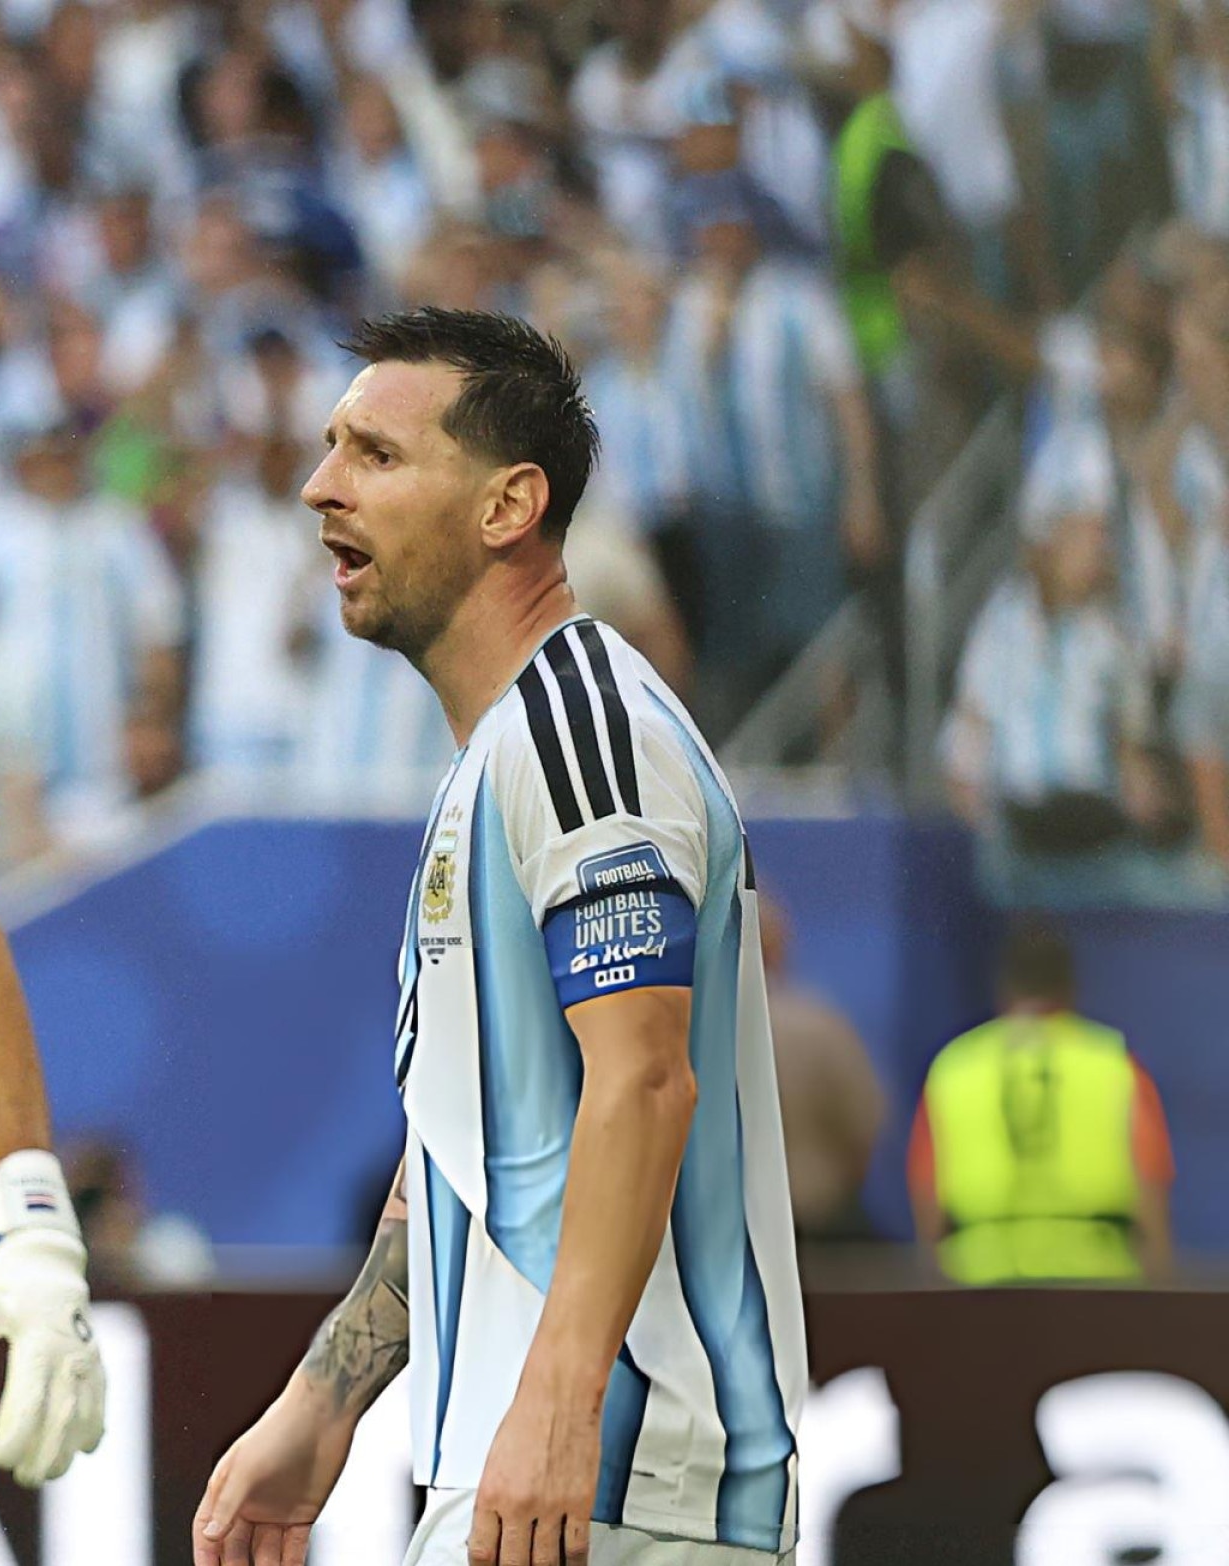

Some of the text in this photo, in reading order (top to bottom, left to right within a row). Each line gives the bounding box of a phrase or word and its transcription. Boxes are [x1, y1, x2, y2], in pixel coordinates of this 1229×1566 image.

[595, 860, 654, 887] FOOTBALL
[575, 890, 660, 923] FOOTBALL
[576, 910, 662, 949] UNITES
